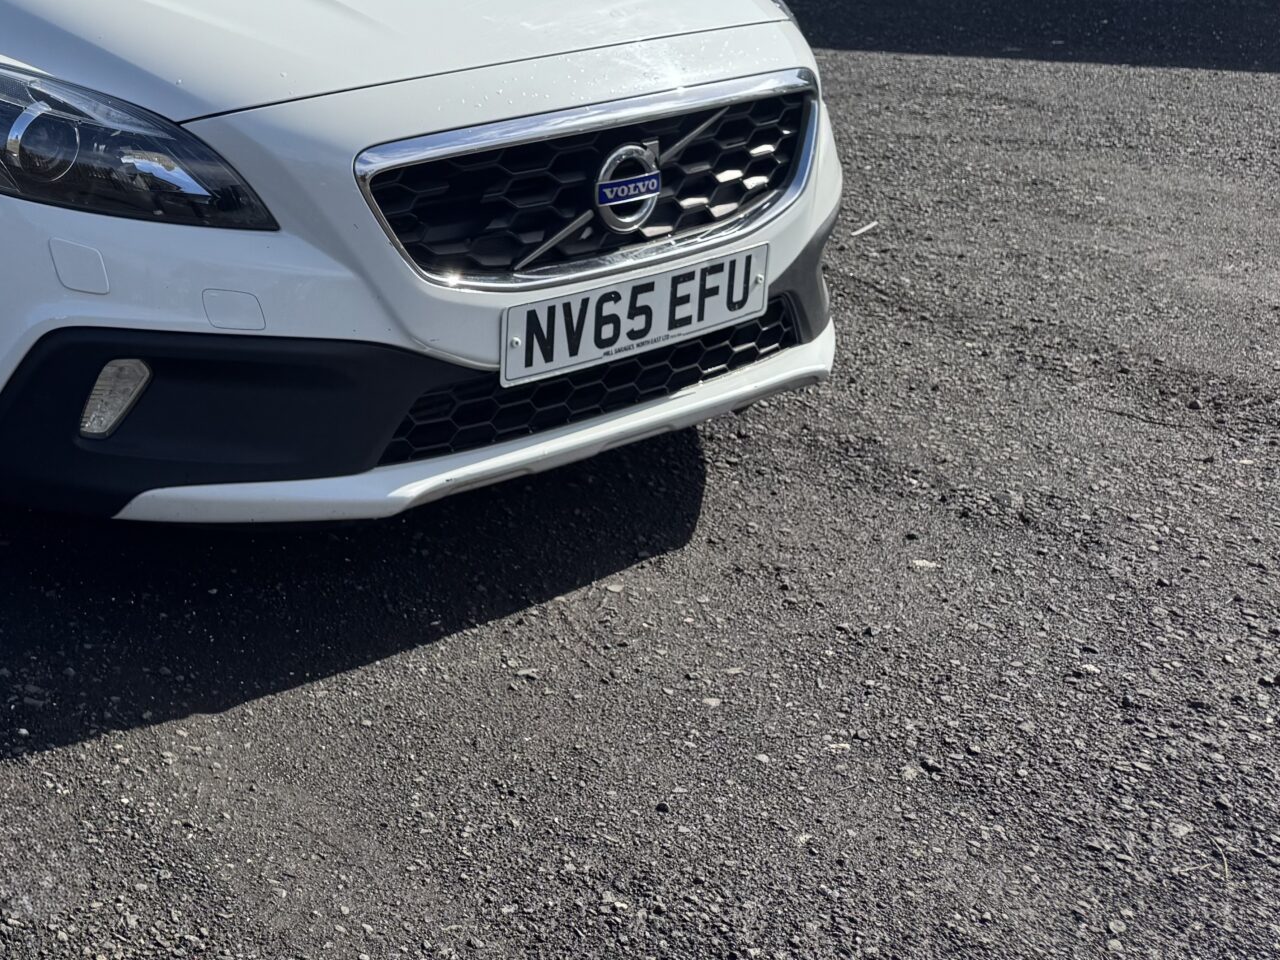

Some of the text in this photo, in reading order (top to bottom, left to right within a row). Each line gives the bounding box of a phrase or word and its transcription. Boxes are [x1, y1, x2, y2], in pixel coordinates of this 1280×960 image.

[602, 178, 657, 200] VOLVO
[524, 254, 752, 368] NV65 EFU
